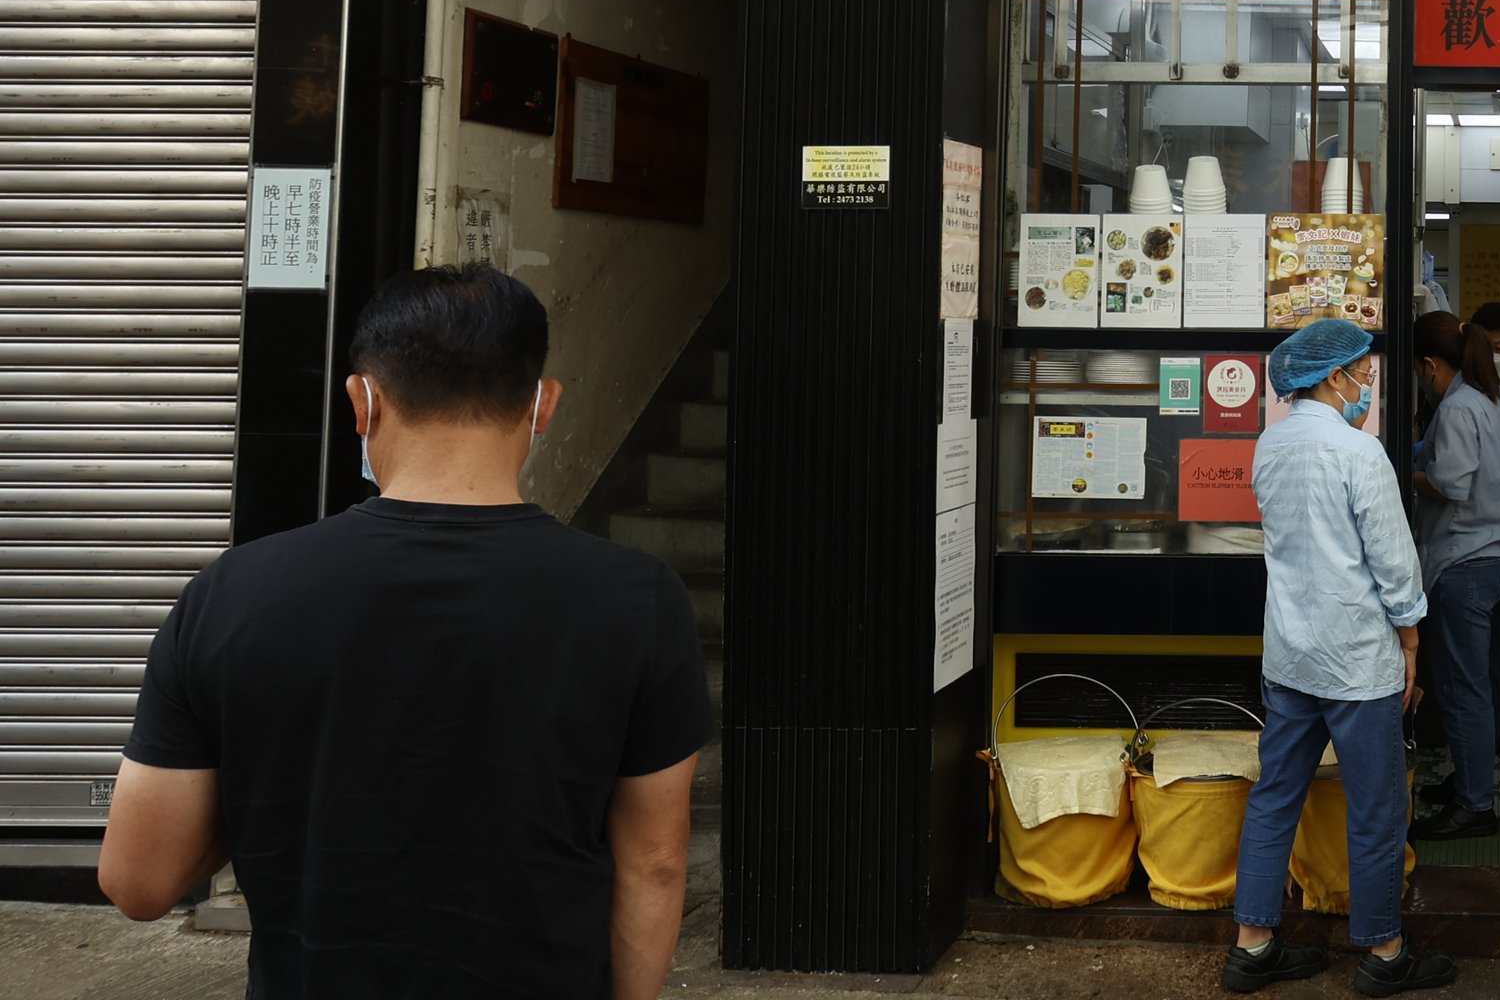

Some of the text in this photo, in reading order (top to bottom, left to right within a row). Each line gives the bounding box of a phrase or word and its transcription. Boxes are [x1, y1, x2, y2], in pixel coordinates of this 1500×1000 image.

[261, 184, 280, 266] 晚上十時正
[283, 184, 303, 267] 早七時半至
[817, 195, 830, 203] Tel
[836, 195, 854, 203] 2473
[855, 195, 874, 203] 2138
[466, 210, 478, 263] 違者
[1192, 467, 1244, 480] 小心地滑
